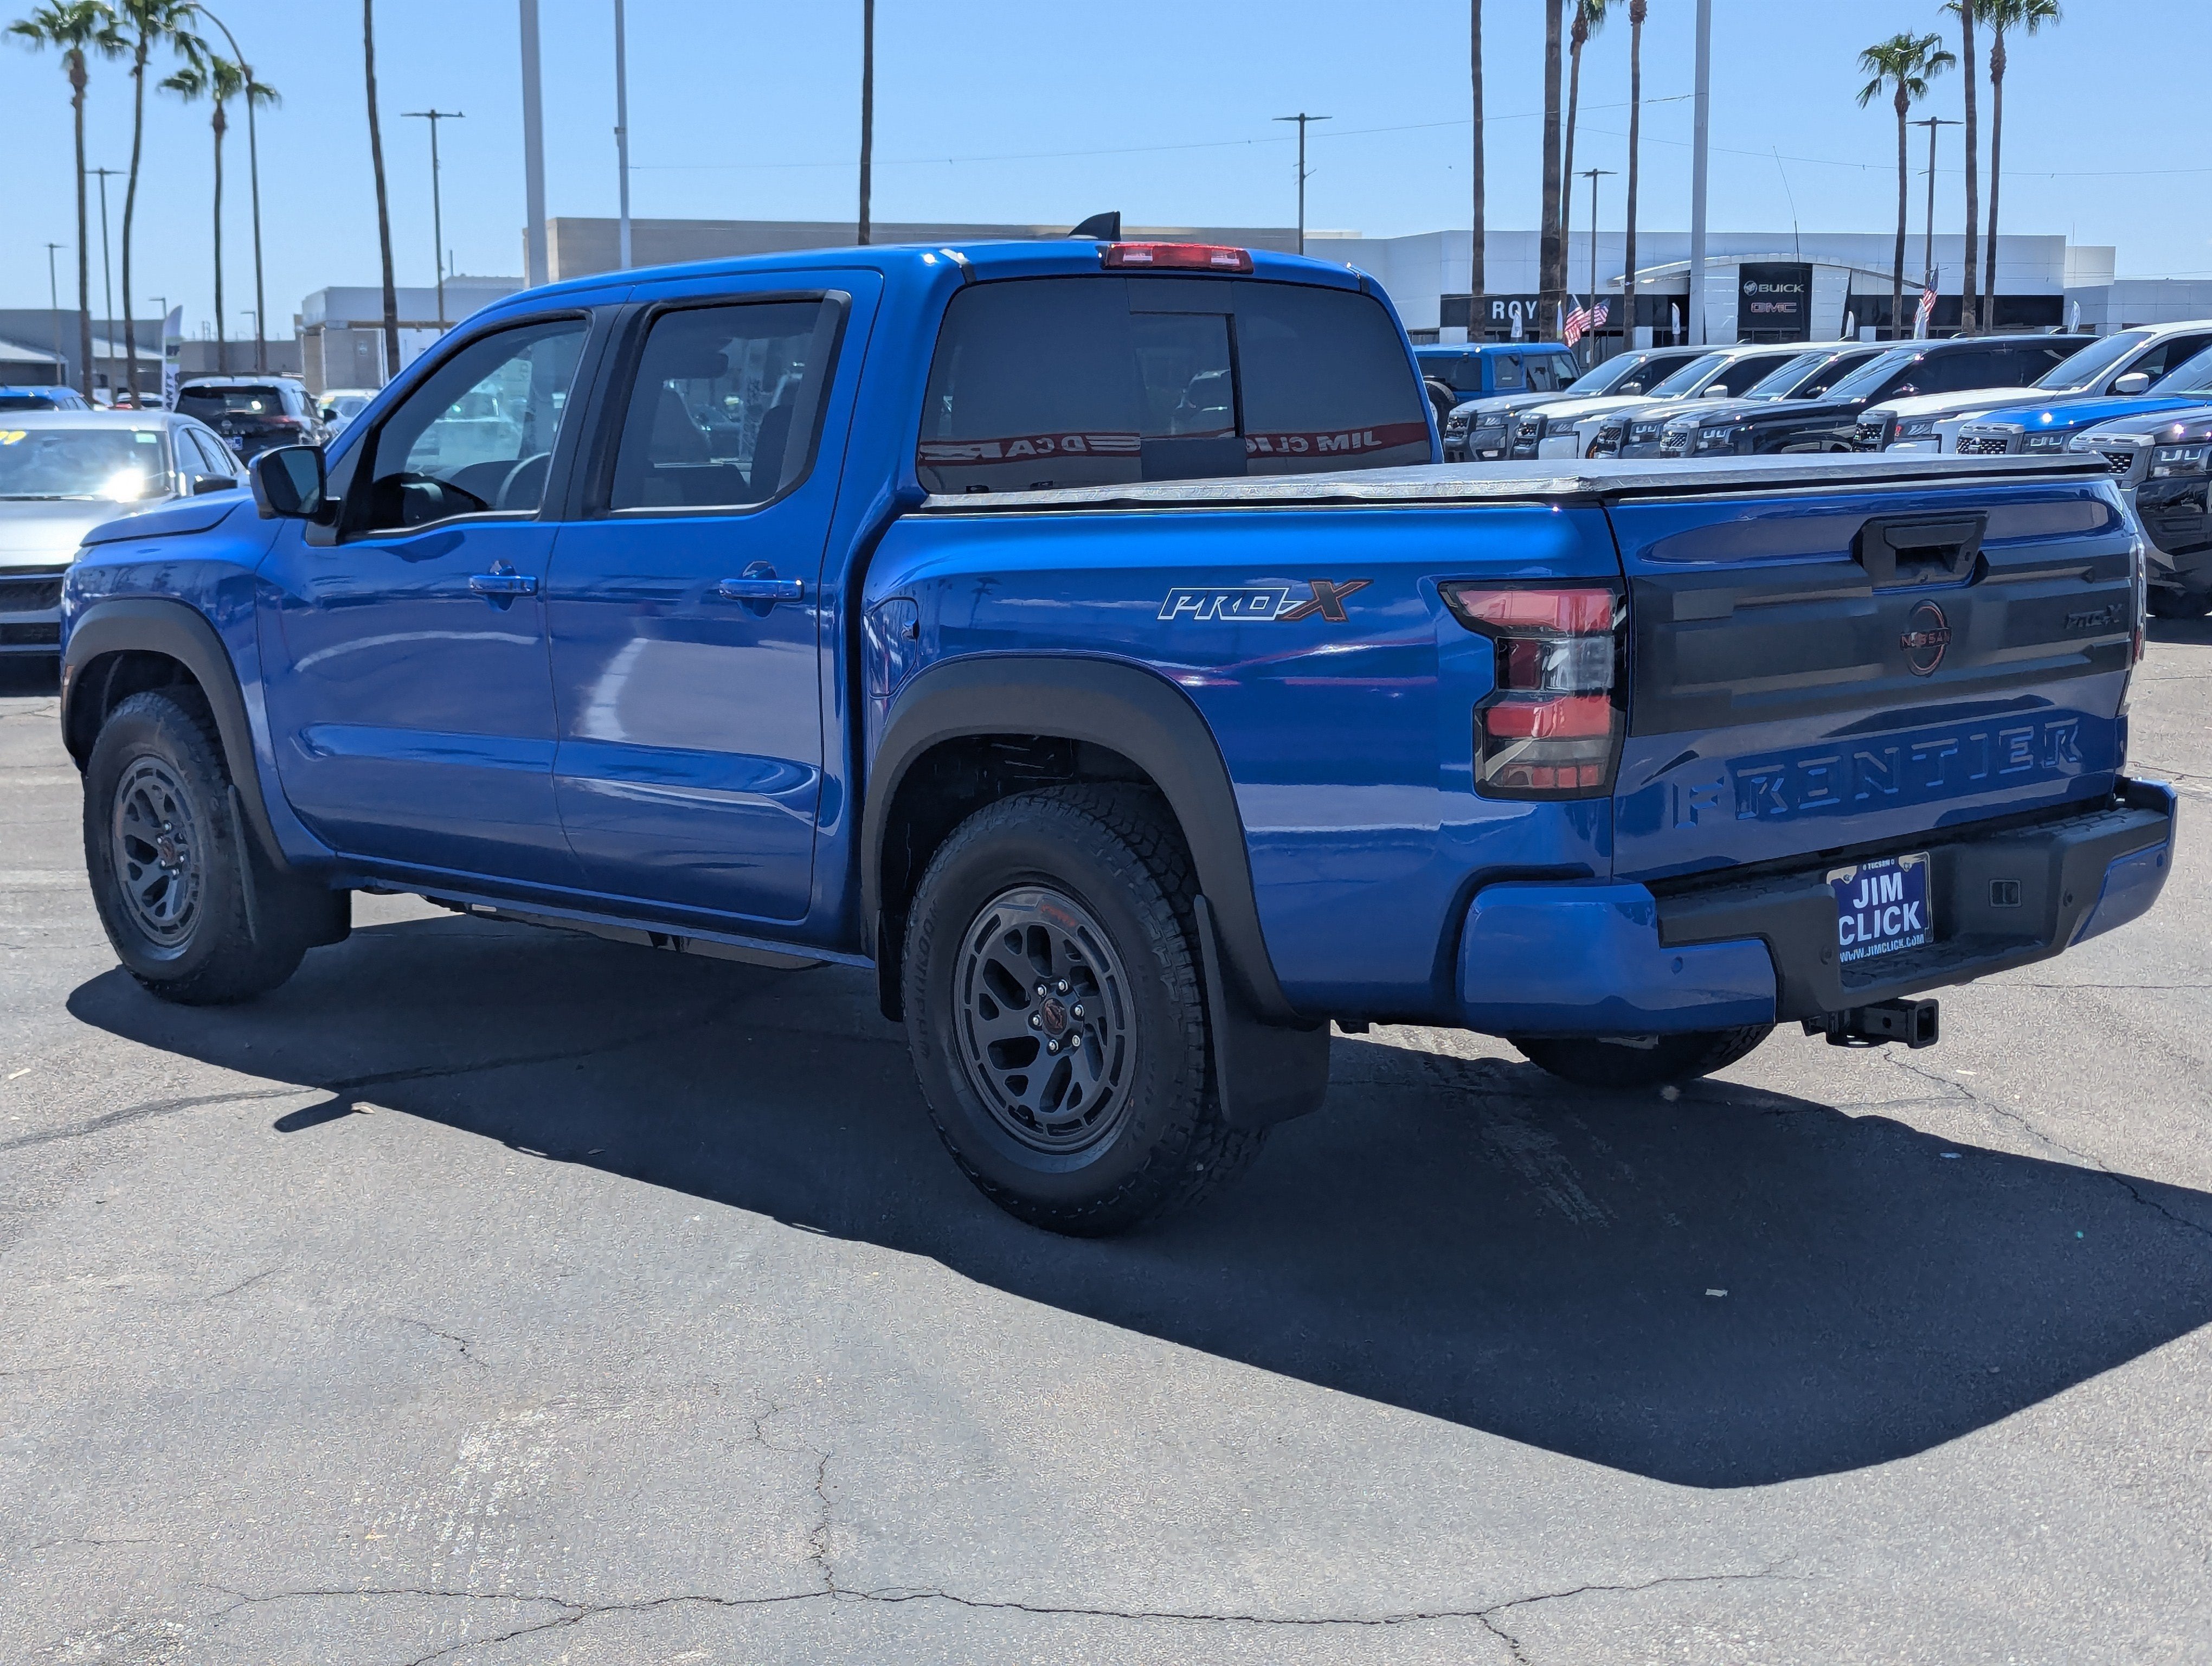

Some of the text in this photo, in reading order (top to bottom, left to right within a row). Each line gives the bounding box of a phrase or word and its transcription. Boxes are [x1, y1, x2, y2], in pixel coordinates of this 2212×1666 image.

[1758, 284, 1805, 293] BUICK
[1492, 300, 1538, 319] ROY
[1751, 302, 1797, 313] GMC
[1156, 578, 1374, 622] PRO-X
[1671, 716, 2084, 830] FRONTIER
[1853, 872, 1904, 909] JIM
[1838, 900, 1922, 946] CLICK
[1840, 933, 1925, 963] WWW.JIMCLICK.COM
